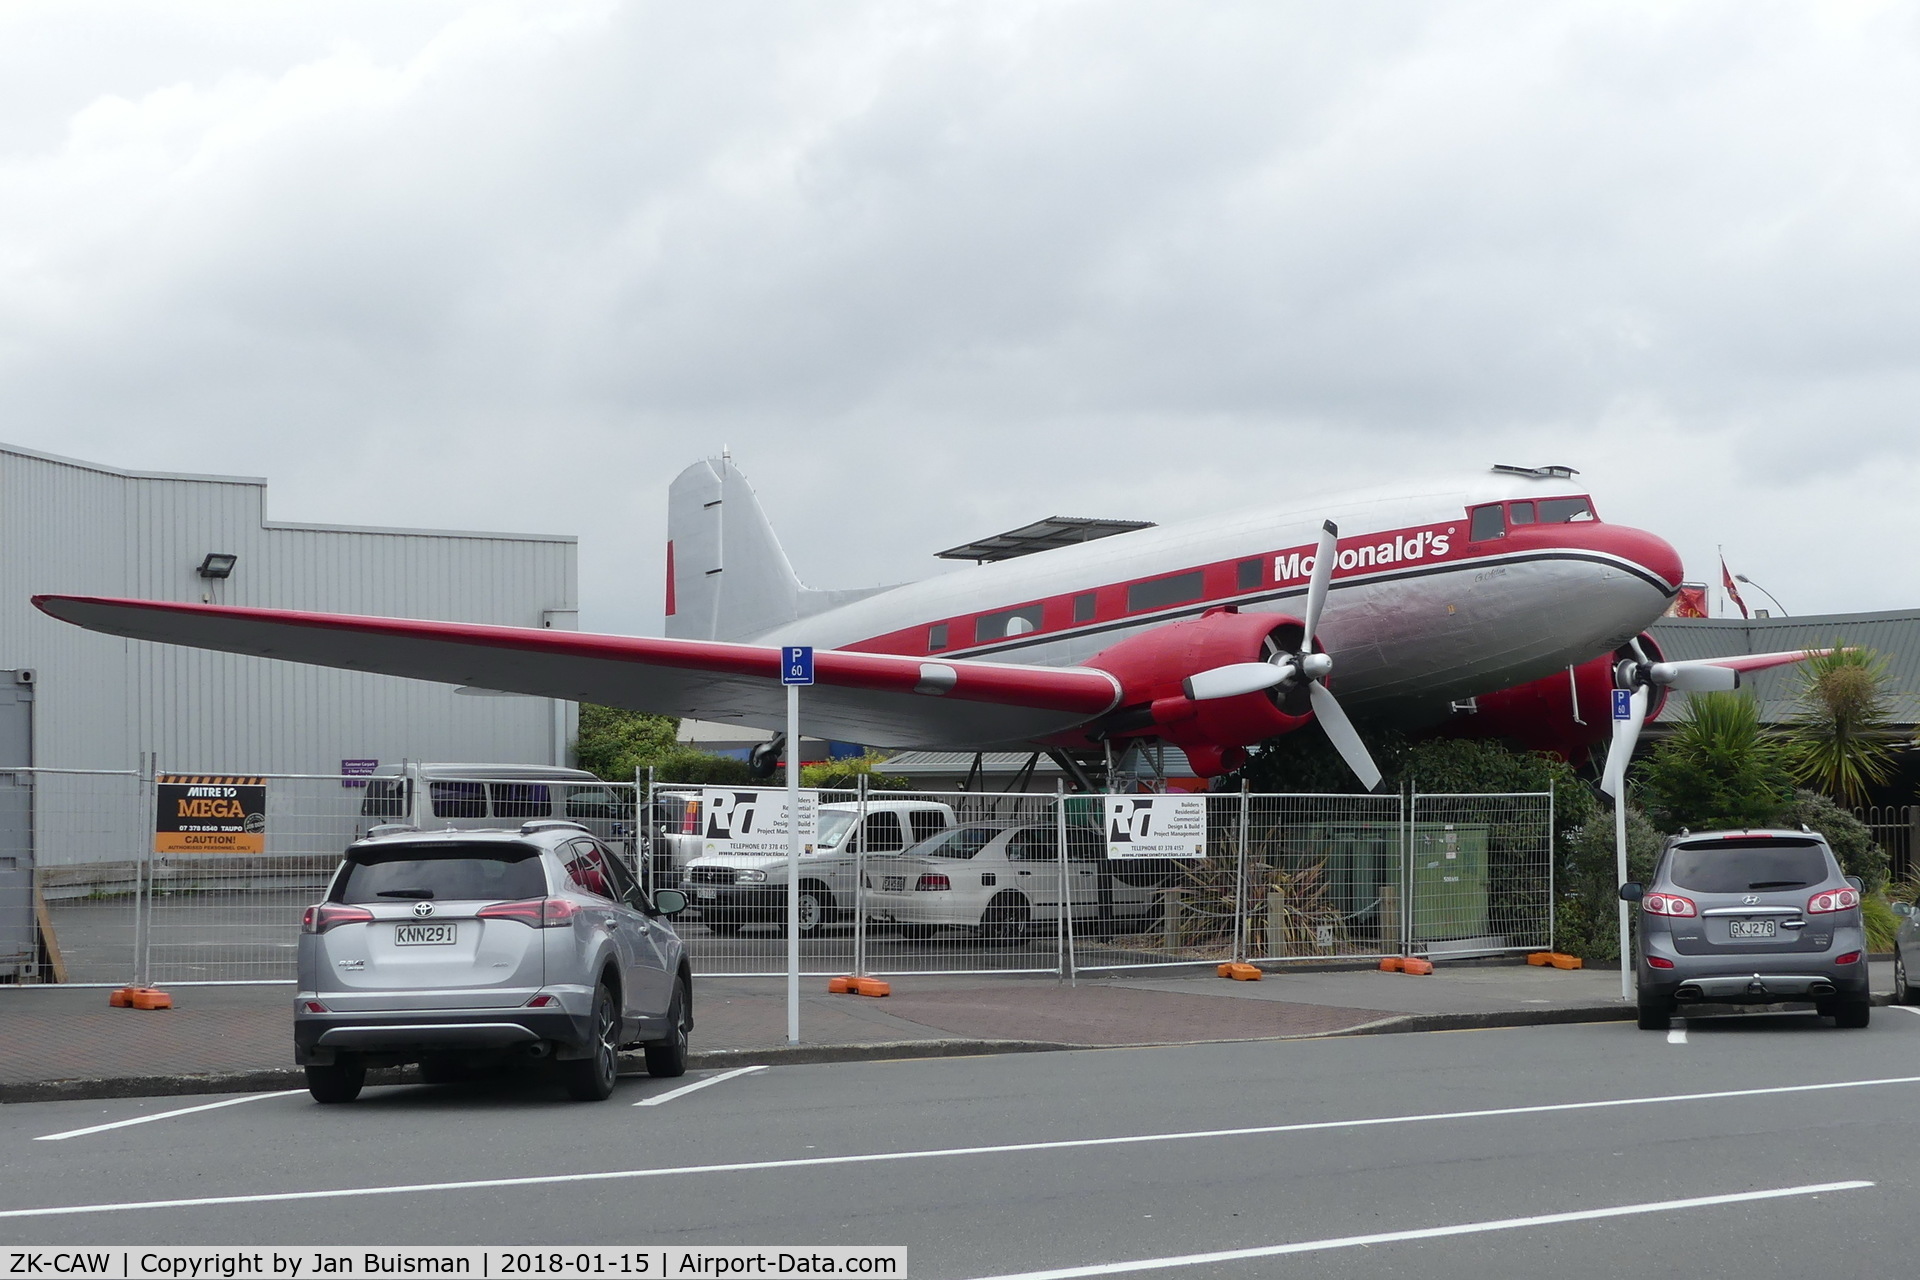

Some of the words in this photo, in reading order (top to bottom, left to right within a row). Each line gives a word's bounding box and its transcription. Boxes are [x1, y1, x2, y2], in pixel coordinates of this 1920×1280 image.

[1274, 531, 1449, 582] Mconald's
[792, 648, 803, 663] P
[791, 665, 803, 676] 60
[1617, 691, 1625, 704] P
[187, 787, 221, 797] MITRE
[223, 787, 237, 798] 10
[177, 799, 246, 818] MEGA
[184, 836, 236, 844] CAUTION!
[397, 926, 452, 943] KNN291
[1732, 922, 1773, 934] GKJ278
